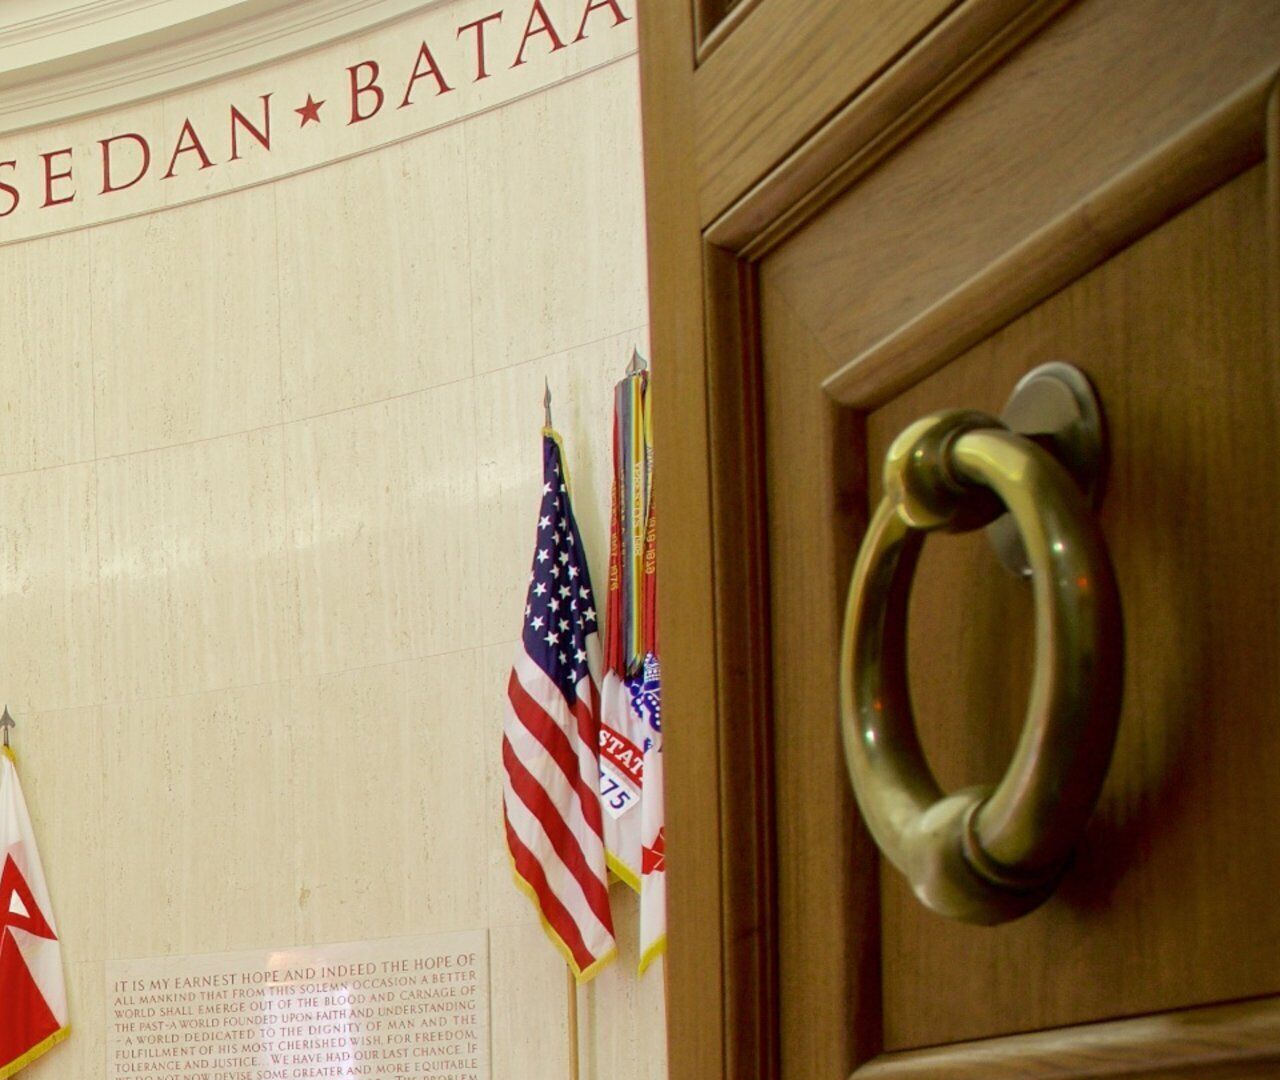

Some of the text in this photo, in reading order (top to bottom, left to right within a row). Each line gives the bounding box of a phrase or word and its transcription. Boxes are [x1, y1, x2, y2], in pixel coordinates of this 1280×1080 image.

[345, 0, 632, 126] BATAA
[114, 953, 476, 993] IT IS MY EARNEST HOPE AND INDEED THE HOPE OF
[114, 970, 476, 1006] ALL MANKIND THAT FROM THIS SOLEMN OCCASION A BETTER
[114, 985, 476, 1019] WORLD SHALL EMERGE OUT OF THE BLOOD AND CARNAGE OF
[115, 1022, 136, 1033] THE
[179, 1017, 220, 1029] WORLD
[223, 1014, 278, 1026] FOUNDED
[282, 1011, 312, 1023] UPON
[316, 1009, 346, 1021] FAITH
[349, 1007, 374, 1018] AND
[378, 1000, 476, 1017] UNDERSTANDING
[115, 1046, 195, 1060] FULFILLMENT
[199, 1045, 214, 1055] OF
[218, 1044, 238, 1054] HIS
[242, 1042, 274, 1053] MOST
[278, 1037, 347, 1051] CHERISHED
[387, 1034, 412, 1045] FOR
[125, 1014, 477, 1046] A WORLD DEDICATED TO THE DIGNITY OF MAN AND THE
